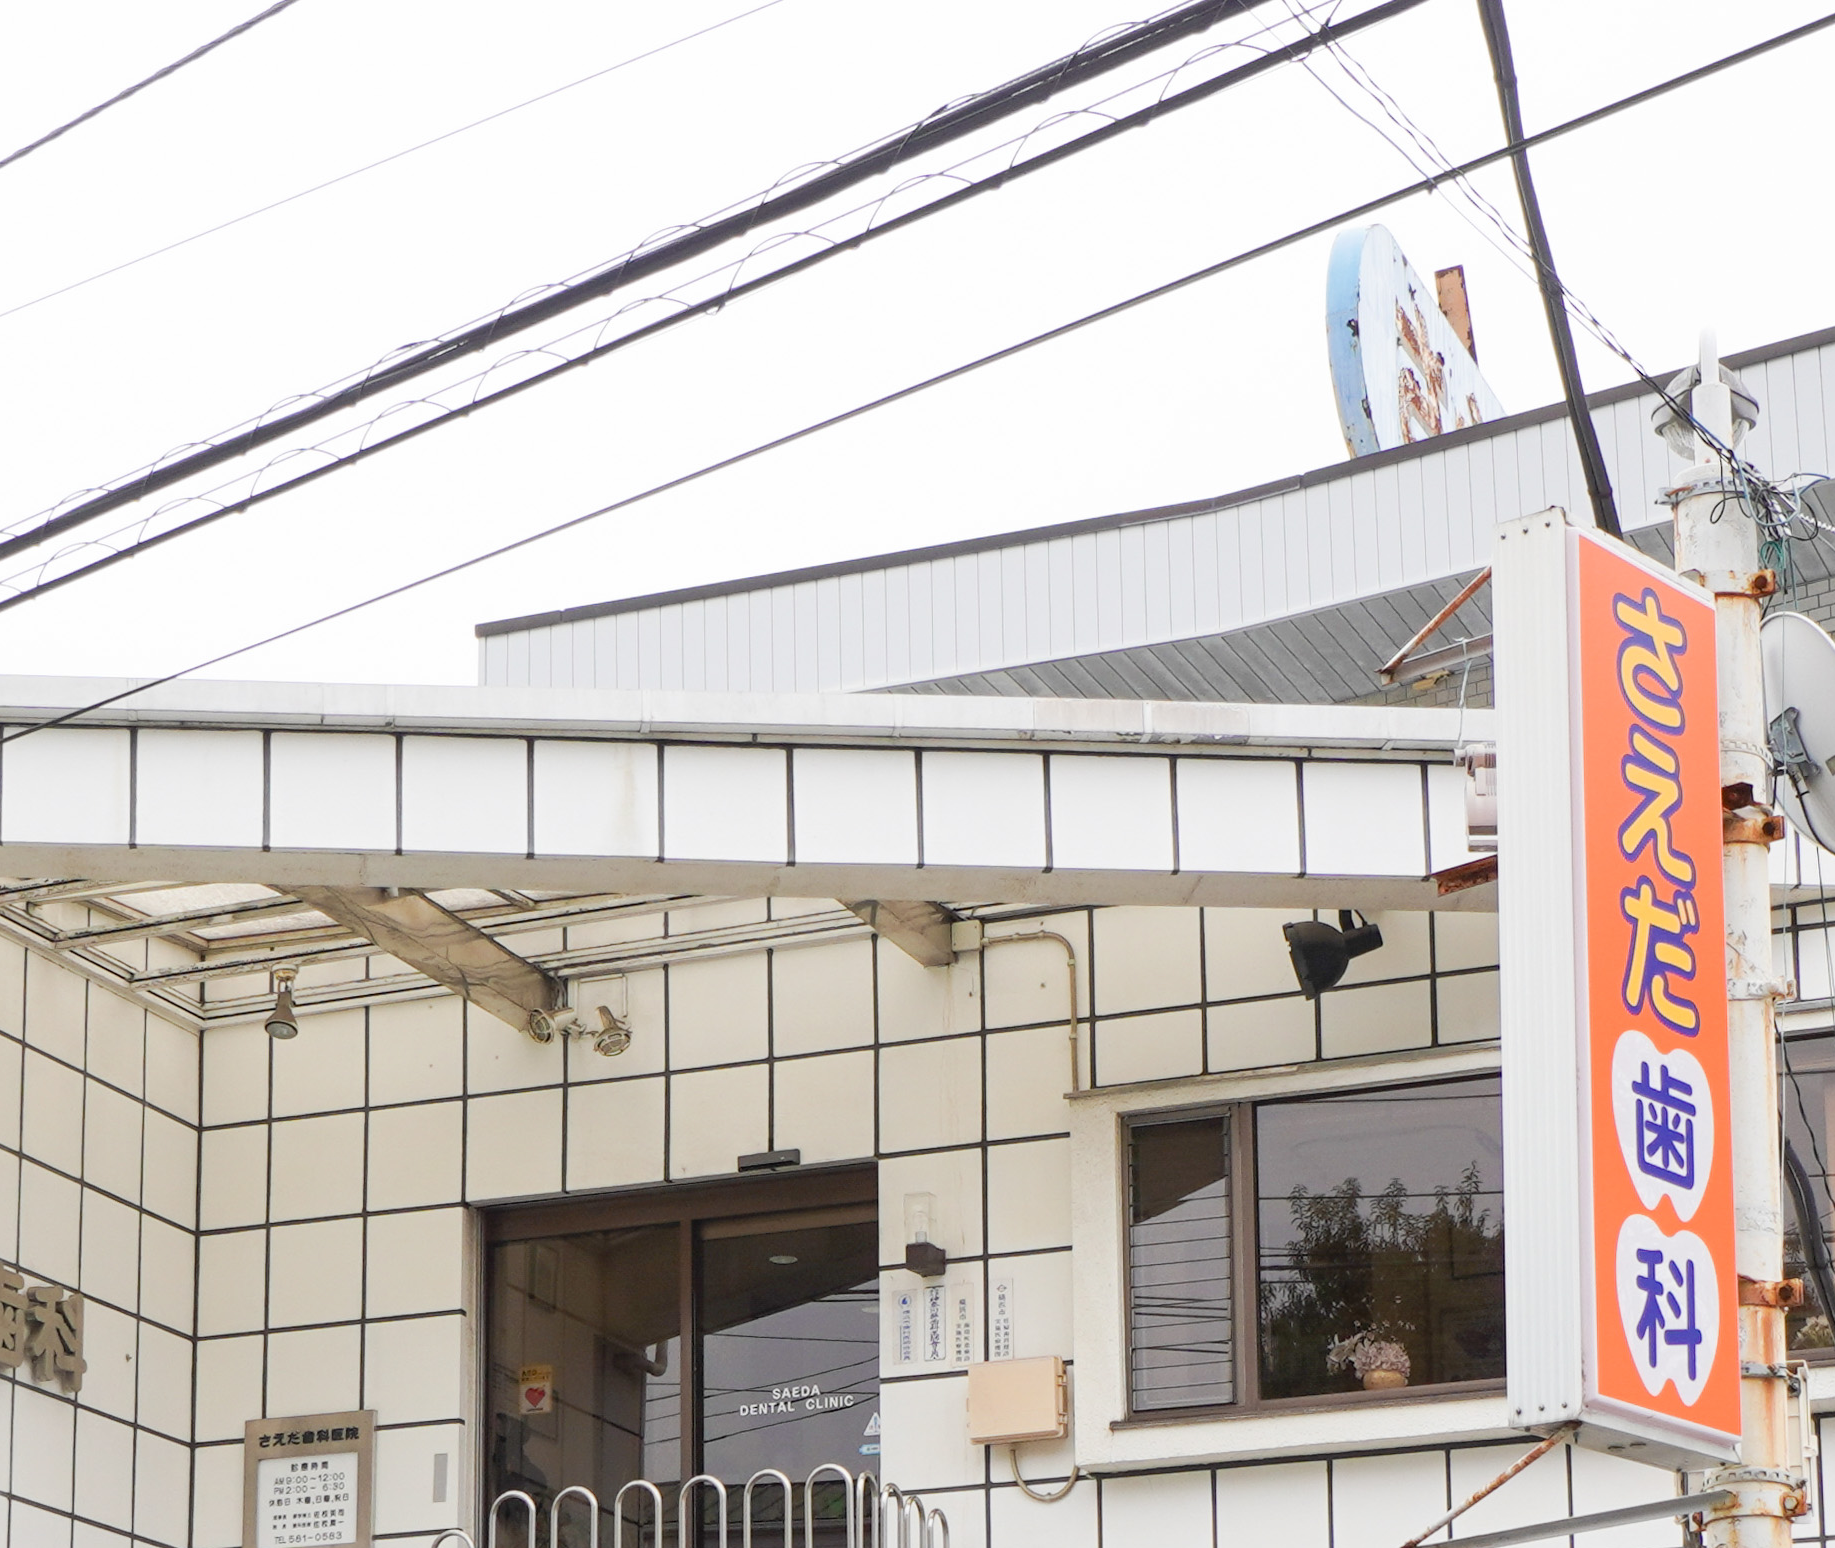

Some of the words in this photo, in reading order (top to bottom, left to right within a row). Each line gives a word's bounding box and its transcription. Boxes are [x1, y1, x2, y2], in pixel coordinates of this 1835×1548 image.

[1613, 586, 1703, 1382] さえだ歯科
[772, 1385, 821, 1400] SAEDA
[739, 1402, 795, 1416] DENTAL
[805, 1395, 855, 1411] CLINIC
[258, 1426, 360, 1448] さえだ歯科医院
[291, 1461, 329, 1472] 診療時間
